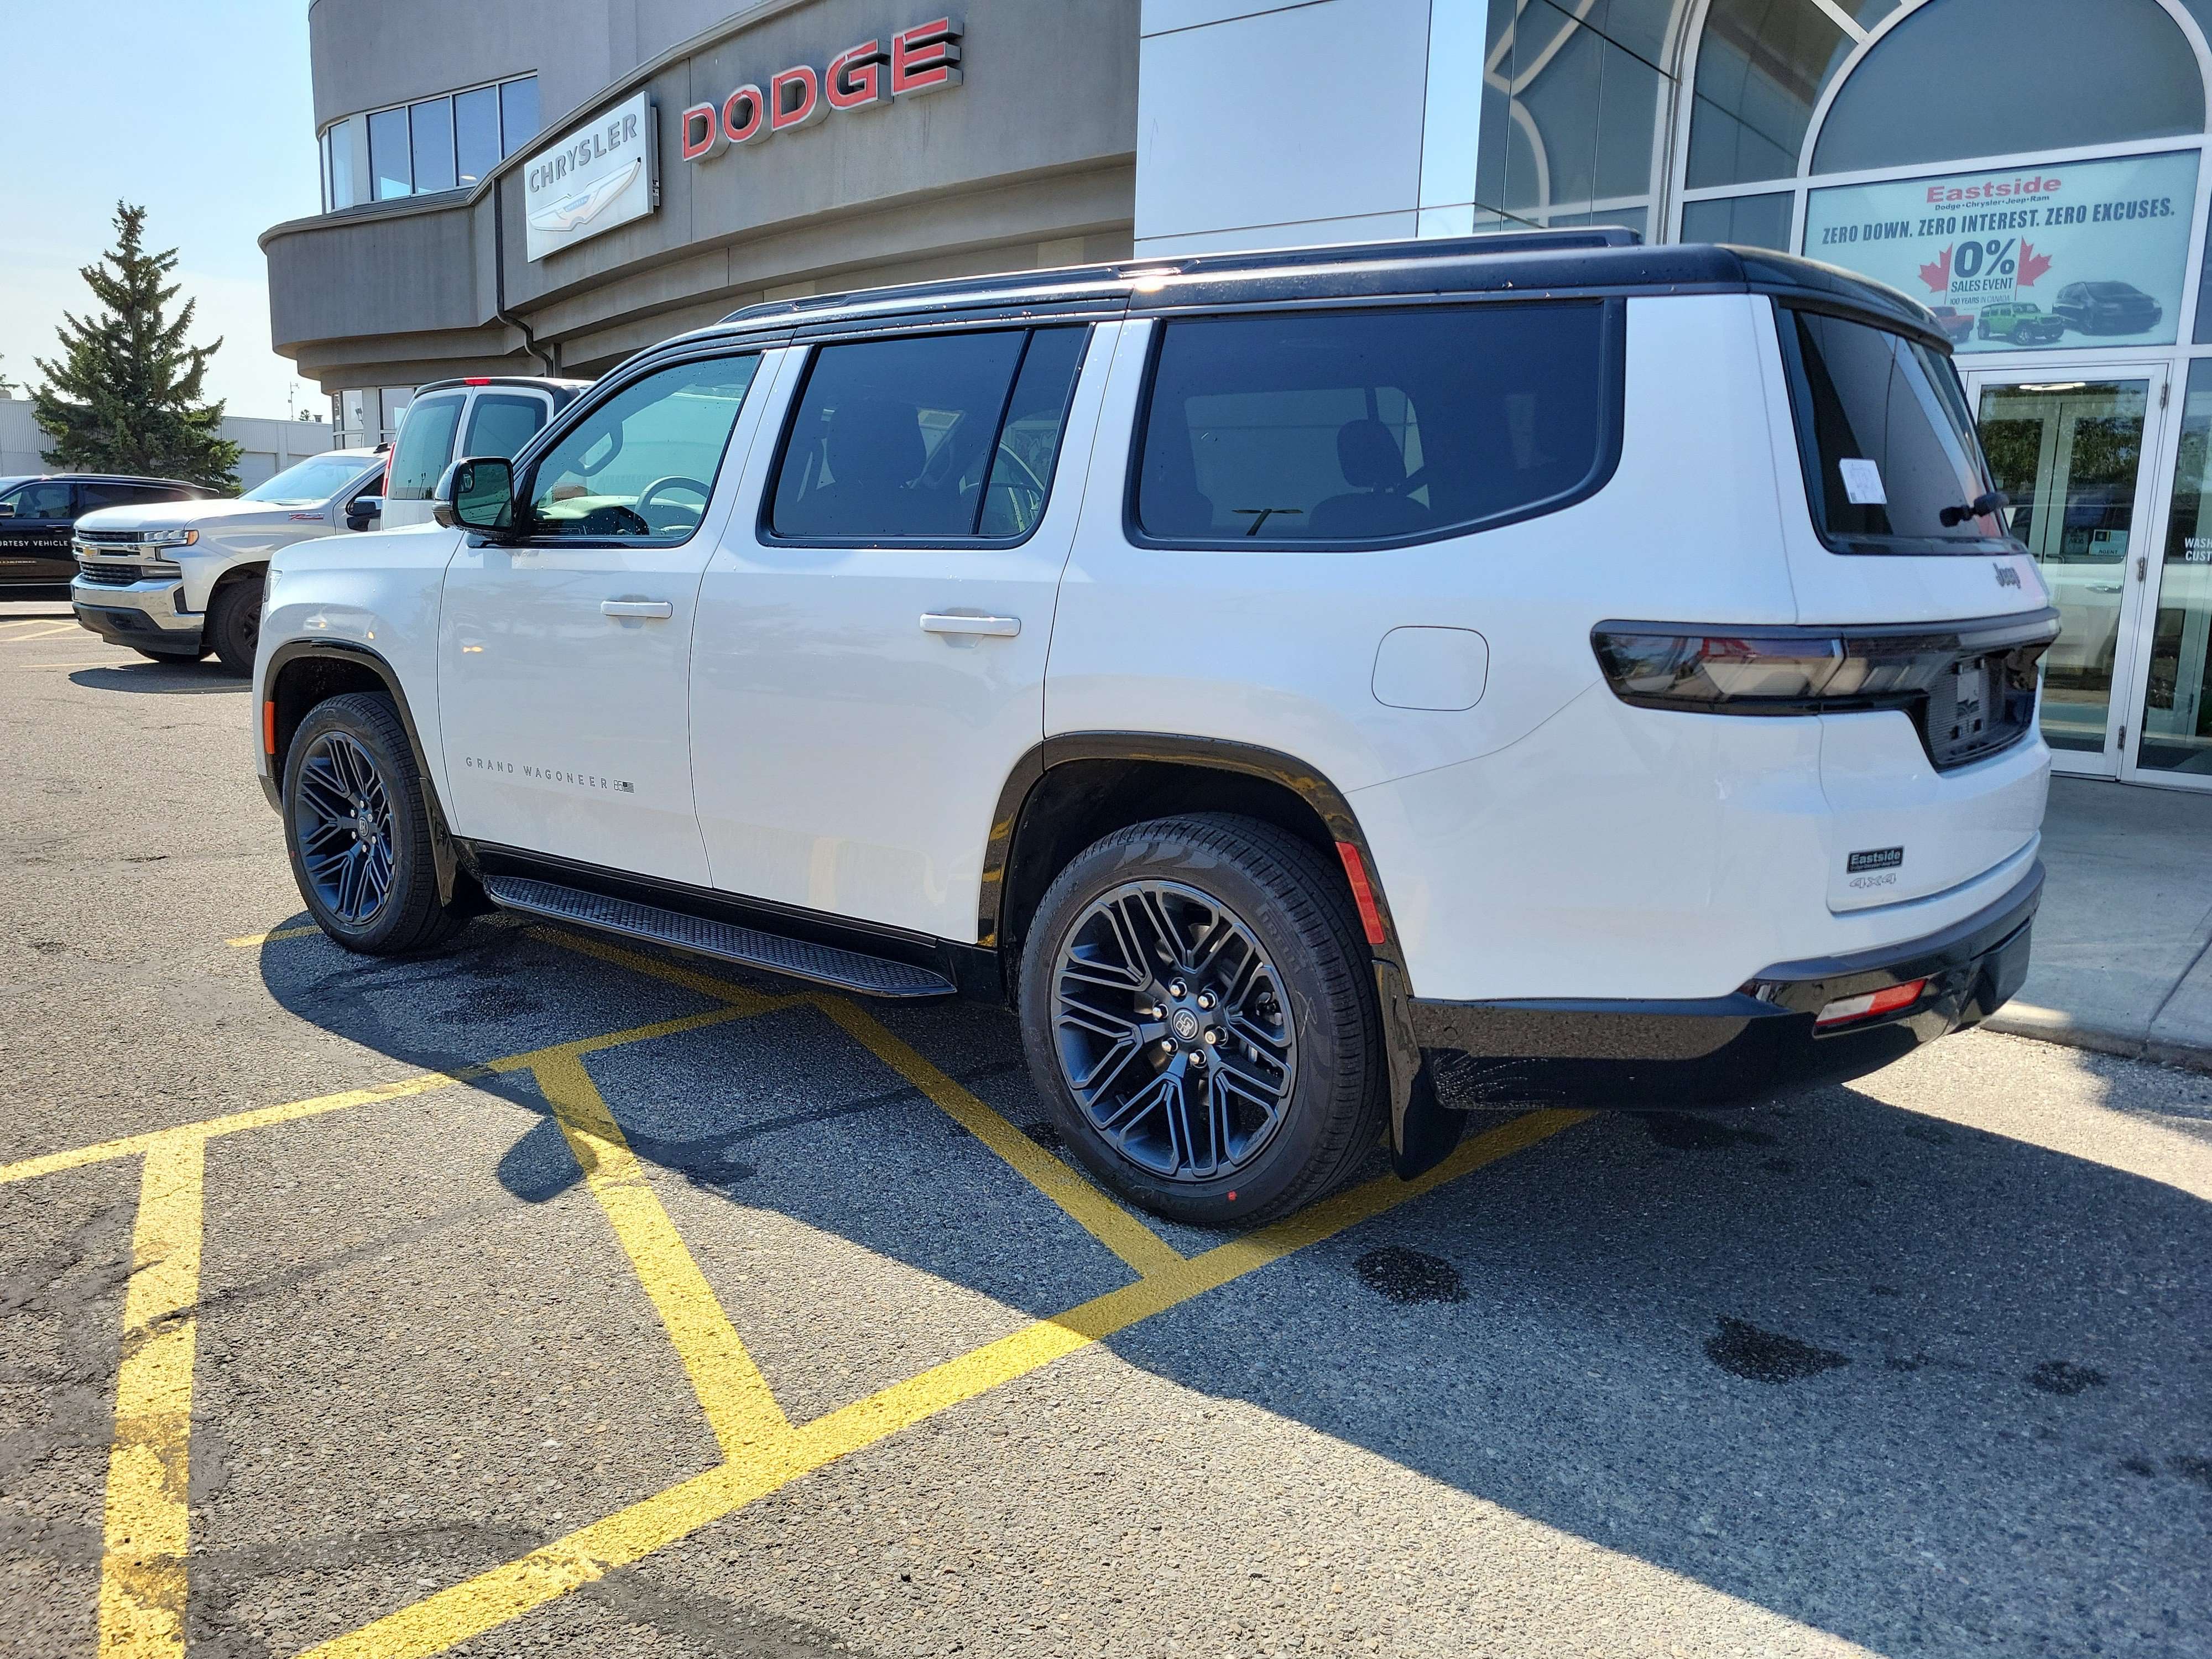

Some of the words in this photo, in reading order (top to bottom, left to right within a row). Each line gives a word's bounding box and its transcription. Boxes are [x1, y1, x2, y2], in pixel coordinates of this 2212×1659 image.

[683, 17, 963, 161] DODGE
[529, 113, 637, 192] CHRYSLER
[1926, 176, 2062, 204] Eastside
[1966, 199, 2002, 208] Chrysler
[1822, 226, 1858, 244] ZERO
[1863, 221, 1913, 241] DOWN.
[1918, 217, 1956, 237] ZERO
[1961, 209, 2040, 233] INTEREST.
[2044, 205, 2087, 226] ZERO
[2093, 197, 2175, 222] EXCUSES.
[1954, 238, 2016, 278] 0%
[1951, 279, 1981, 293] SALES
[1983, 278, 2013, 291] EVENT
[466, 757, 514, 773] GRAND
[523, 765, 607, 789] WAGONEER
[1851, 850, 1901, 865] Eastside
